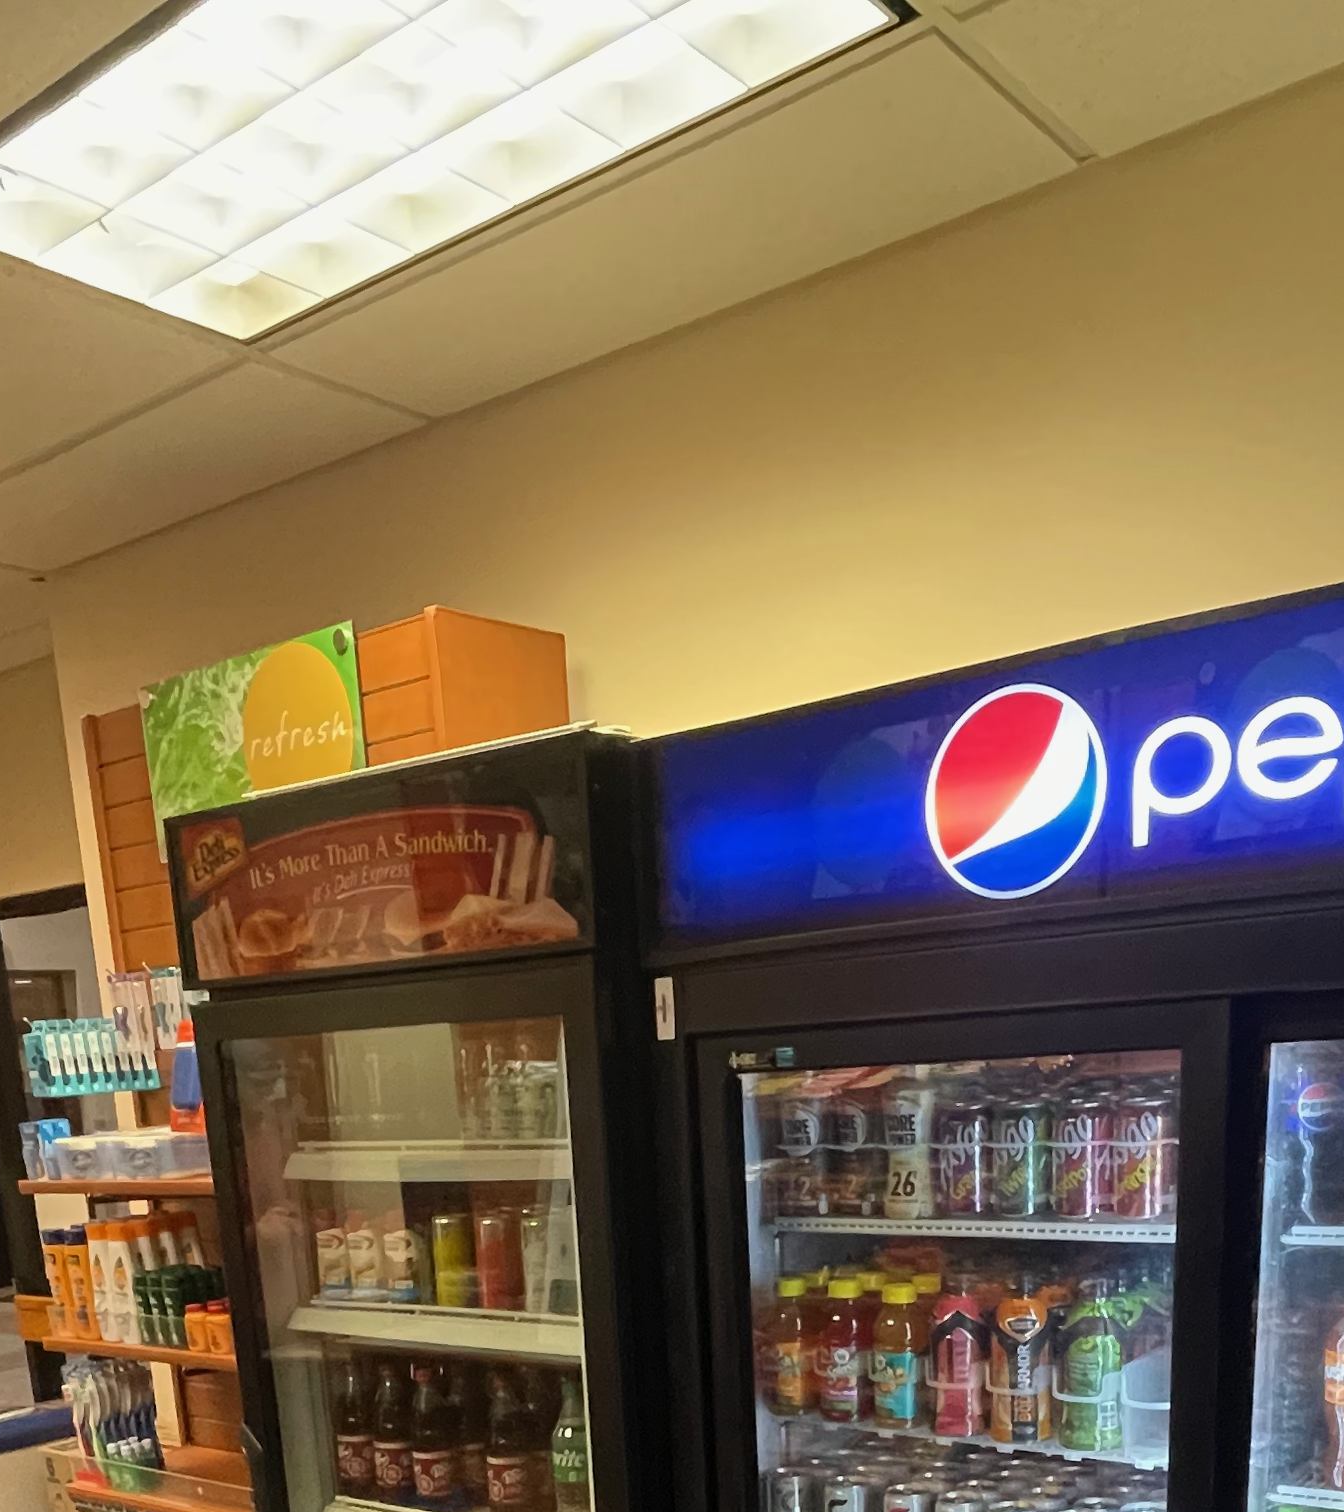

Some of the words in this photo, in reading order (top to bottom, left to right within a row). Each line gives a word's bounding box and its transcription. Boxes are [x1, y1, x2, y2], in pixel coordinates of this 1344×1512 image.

[249, 710, 347, 761] refresh
[248, 865, 276, 890] It's
[279, 853, 321, 880] More
[325, 840, 370, 868] Than
[375, 833, 390, 858] A
[394, 829, 493, 857] Sandwich.
[890, 1170, 917, 1197] 26
